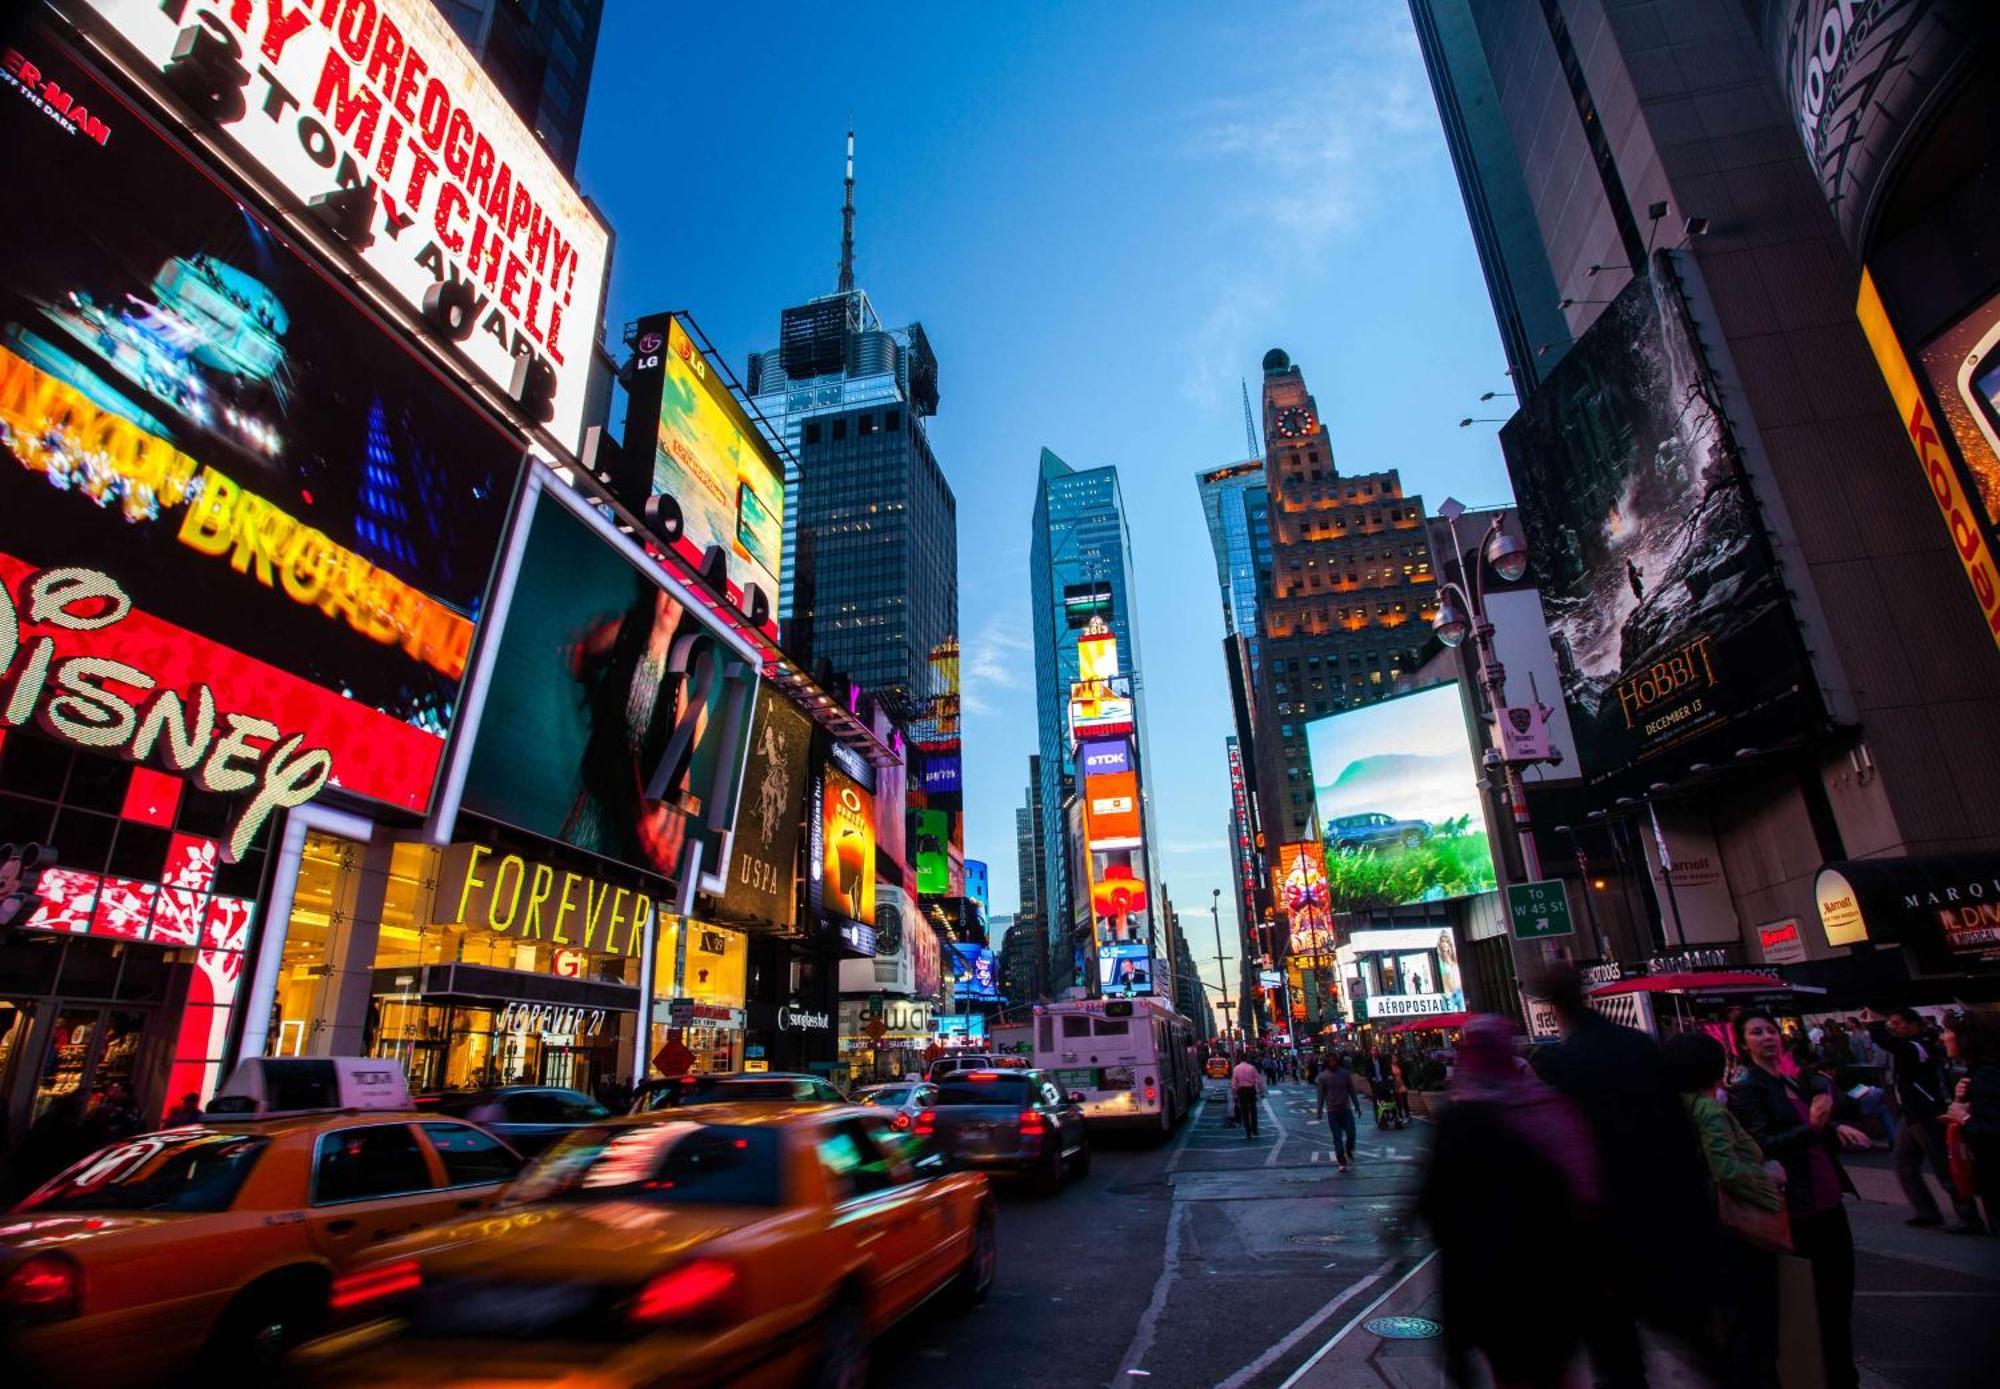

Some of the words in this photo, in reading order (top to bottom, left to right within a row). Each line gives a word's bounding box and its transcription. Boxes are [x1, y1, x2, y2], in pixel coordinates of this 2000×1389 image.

[20, 85, 43, 107] THE
[43, 104, 77, 135] DARK
[313, 46, 565, 366] MITCHELL
[638, 355, 659, 370] LG
[690, 352, 705, 380] LG
[1645, 706, 1692, 736] DECEMBER
[741, 853, 778, 896] USPA
[456, 843, 652, 958] FOREVER
[1515, 904, 1526, 917] W
[1531, 902, 1548, 914] 45
[502, 1002, 584, 1035] FOREVER
[587, 1010, 606, 1037] 21
[1378, 998, 1451, 1014] AÉROPOSTALE
